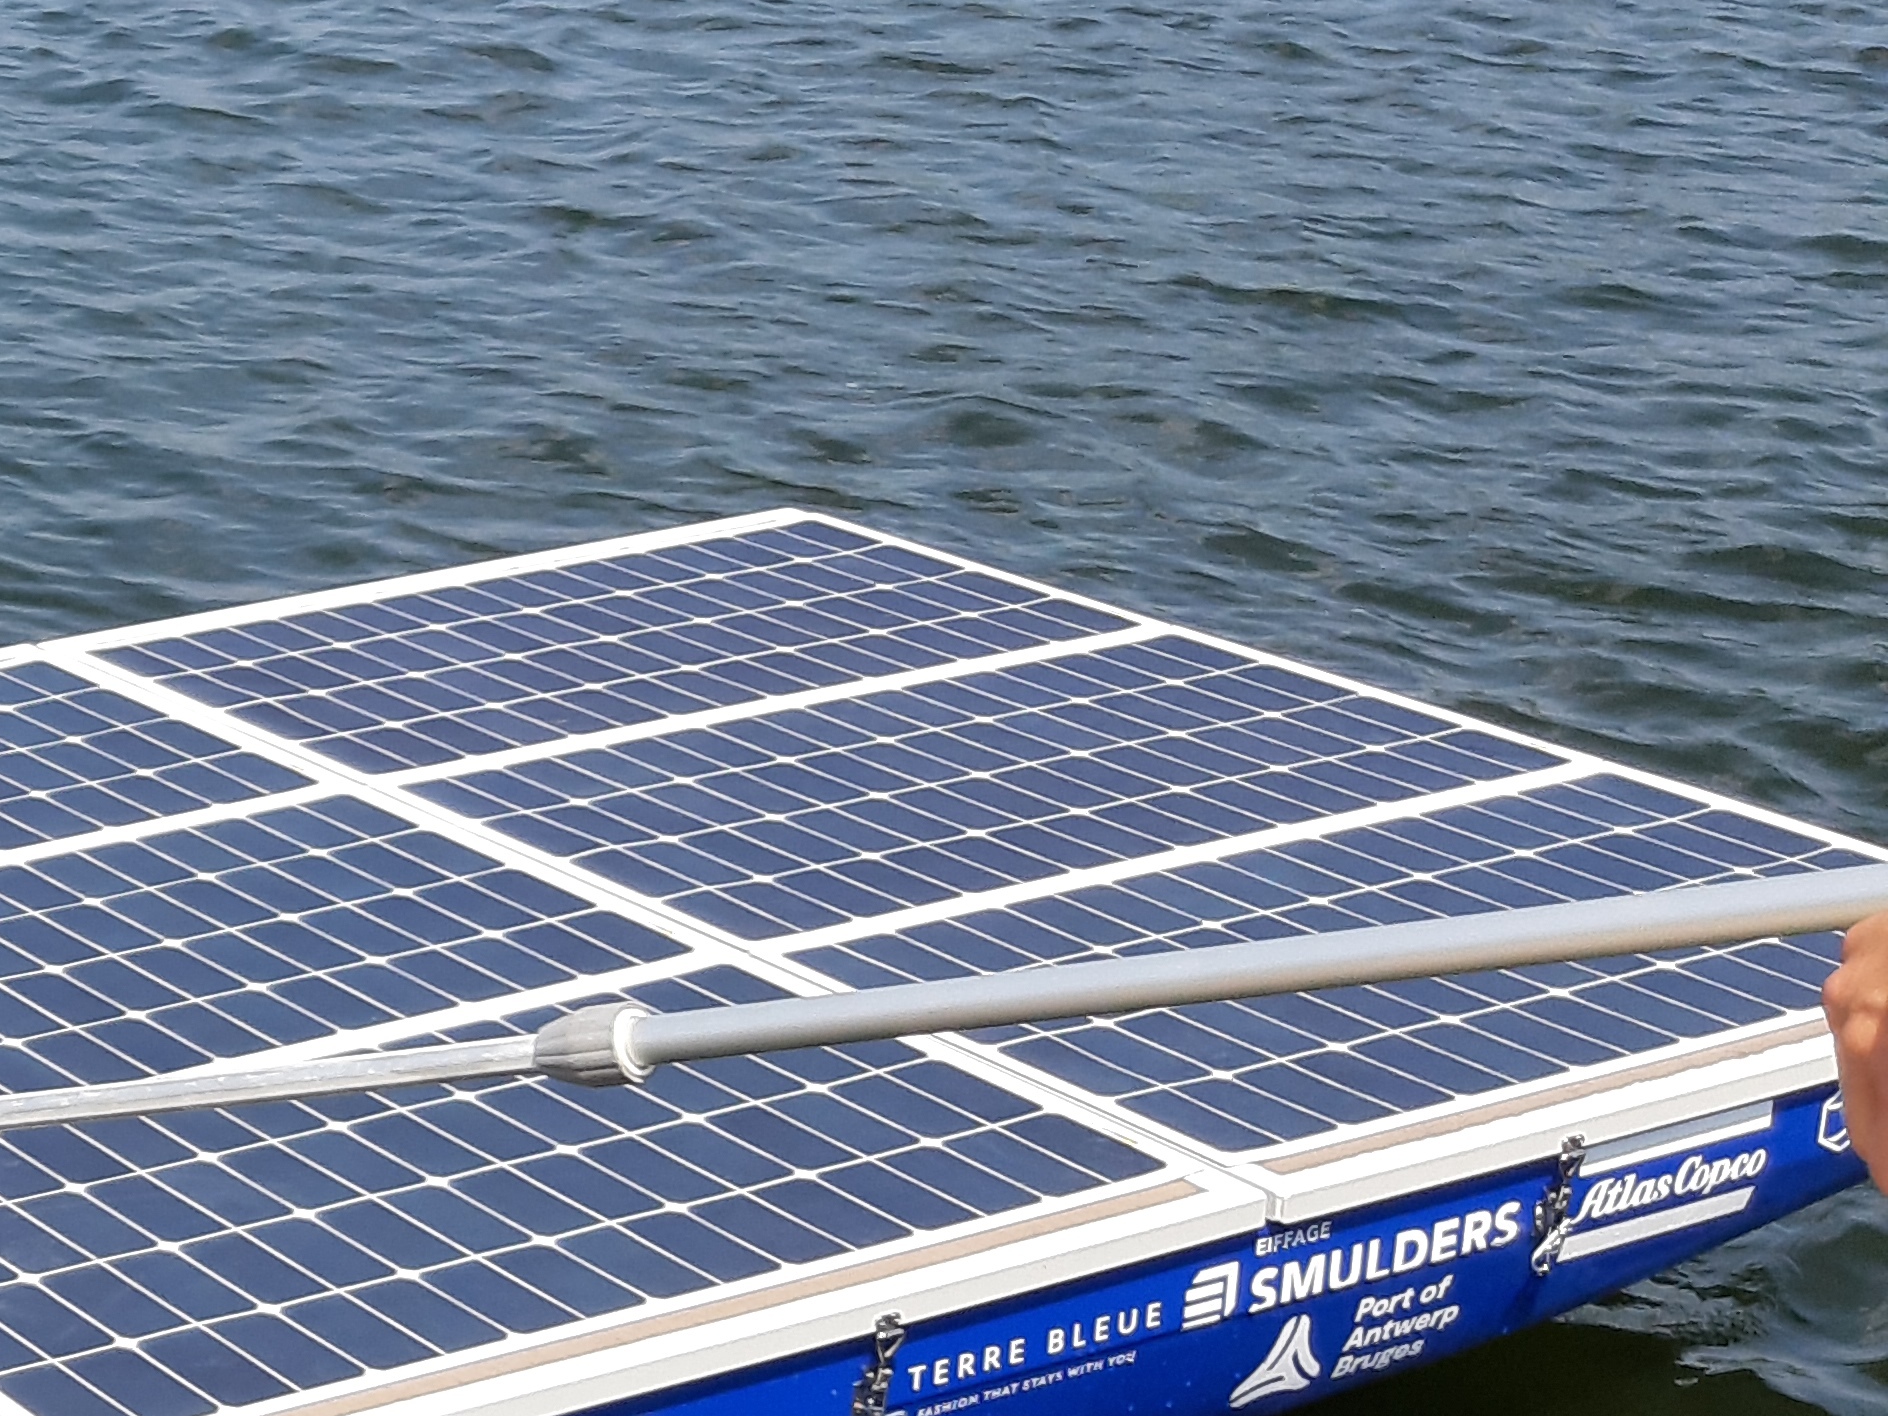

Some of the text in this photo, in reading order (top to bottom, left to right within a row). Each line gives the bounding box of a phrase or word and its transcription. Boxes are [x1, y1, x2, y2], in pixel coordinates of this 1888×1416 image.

[1248, 1200, 1521, 1315] SMULDERS
[1254, 1220, 1333, 1257] EIFFAGE
[1354, 1274, 1454, 1323] Port of
[907, 1301, 1162, 1392] TERRE BLEUE
[1342, 1304, 1460, 1353] Antwerp
[983, 1381, 1021, 1402] THAT
[1067, 1358, 1104, 1378] WITH
